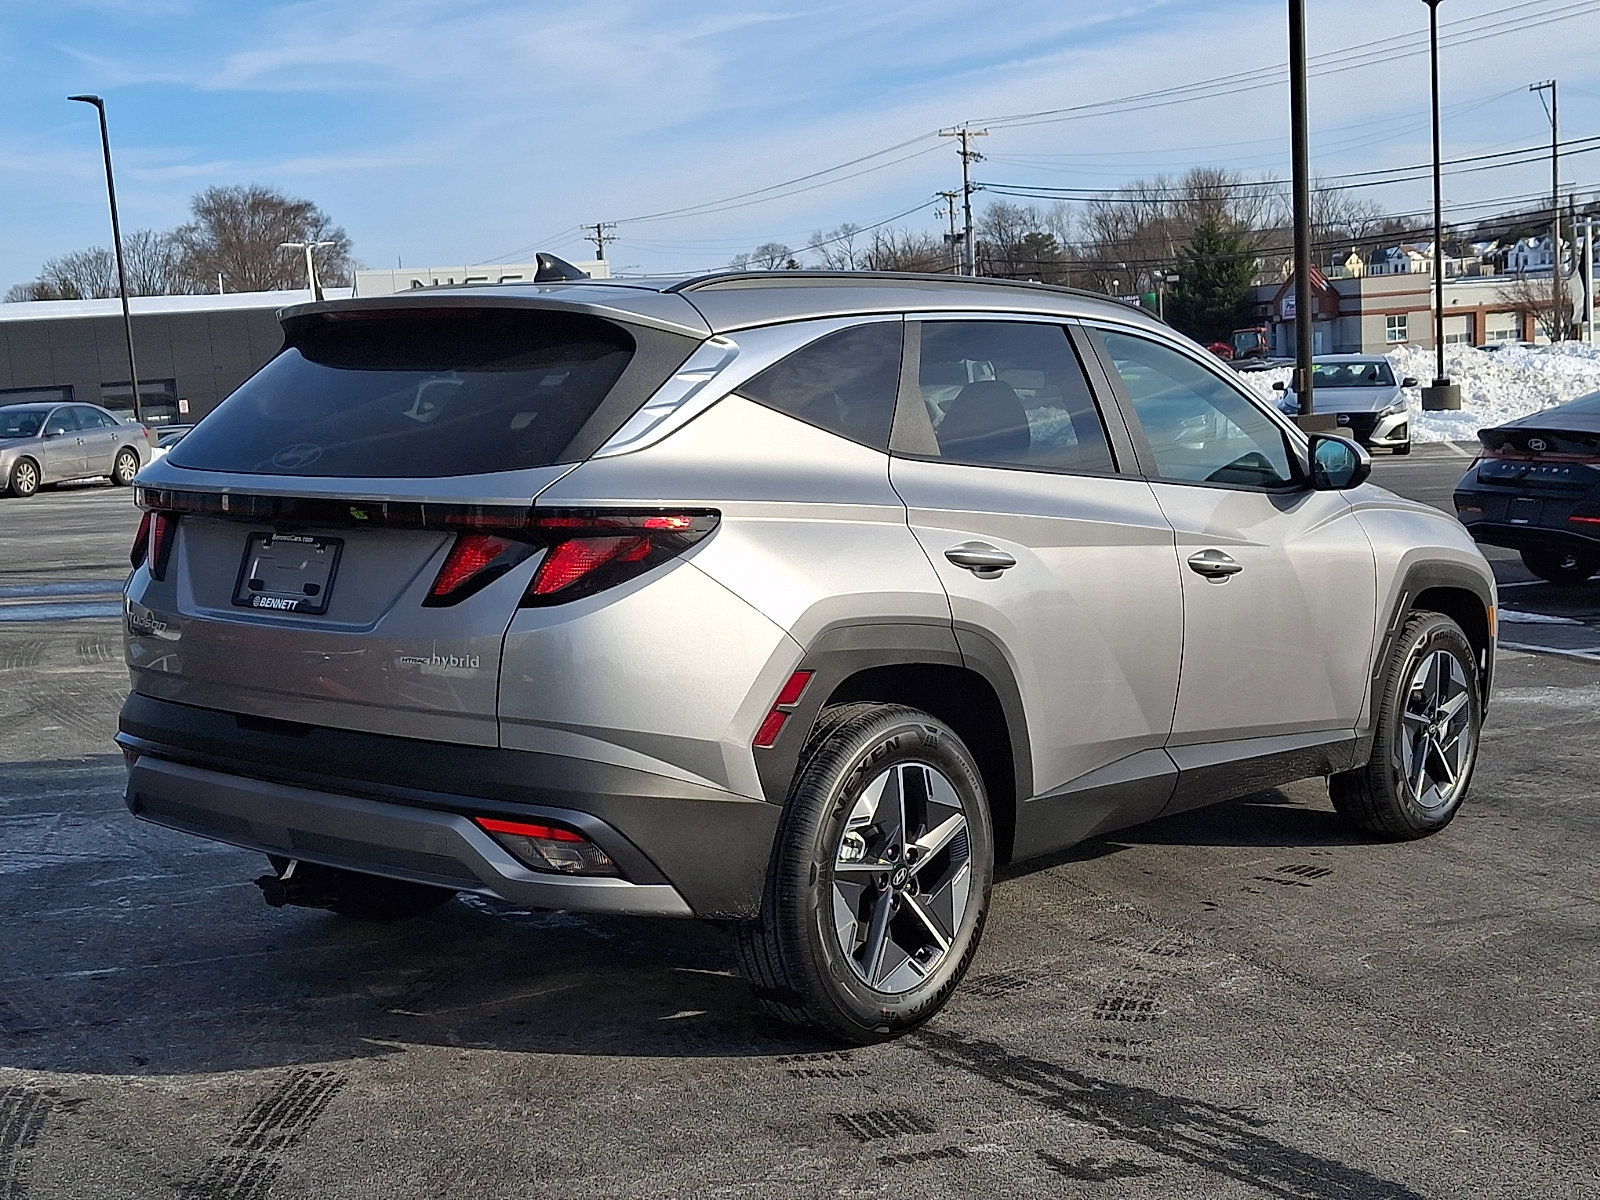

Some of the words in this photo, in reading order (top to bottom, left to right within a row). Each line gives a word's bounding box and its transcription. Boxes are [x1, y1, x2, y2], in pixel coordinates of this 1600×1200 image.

[1501, 464, 1570, 474] ELANTRA
[259, 597, 299, 611] BENNETT
[432, 652, 480, 670] hybrid
[832, 736, 900, 821] NEXEN
